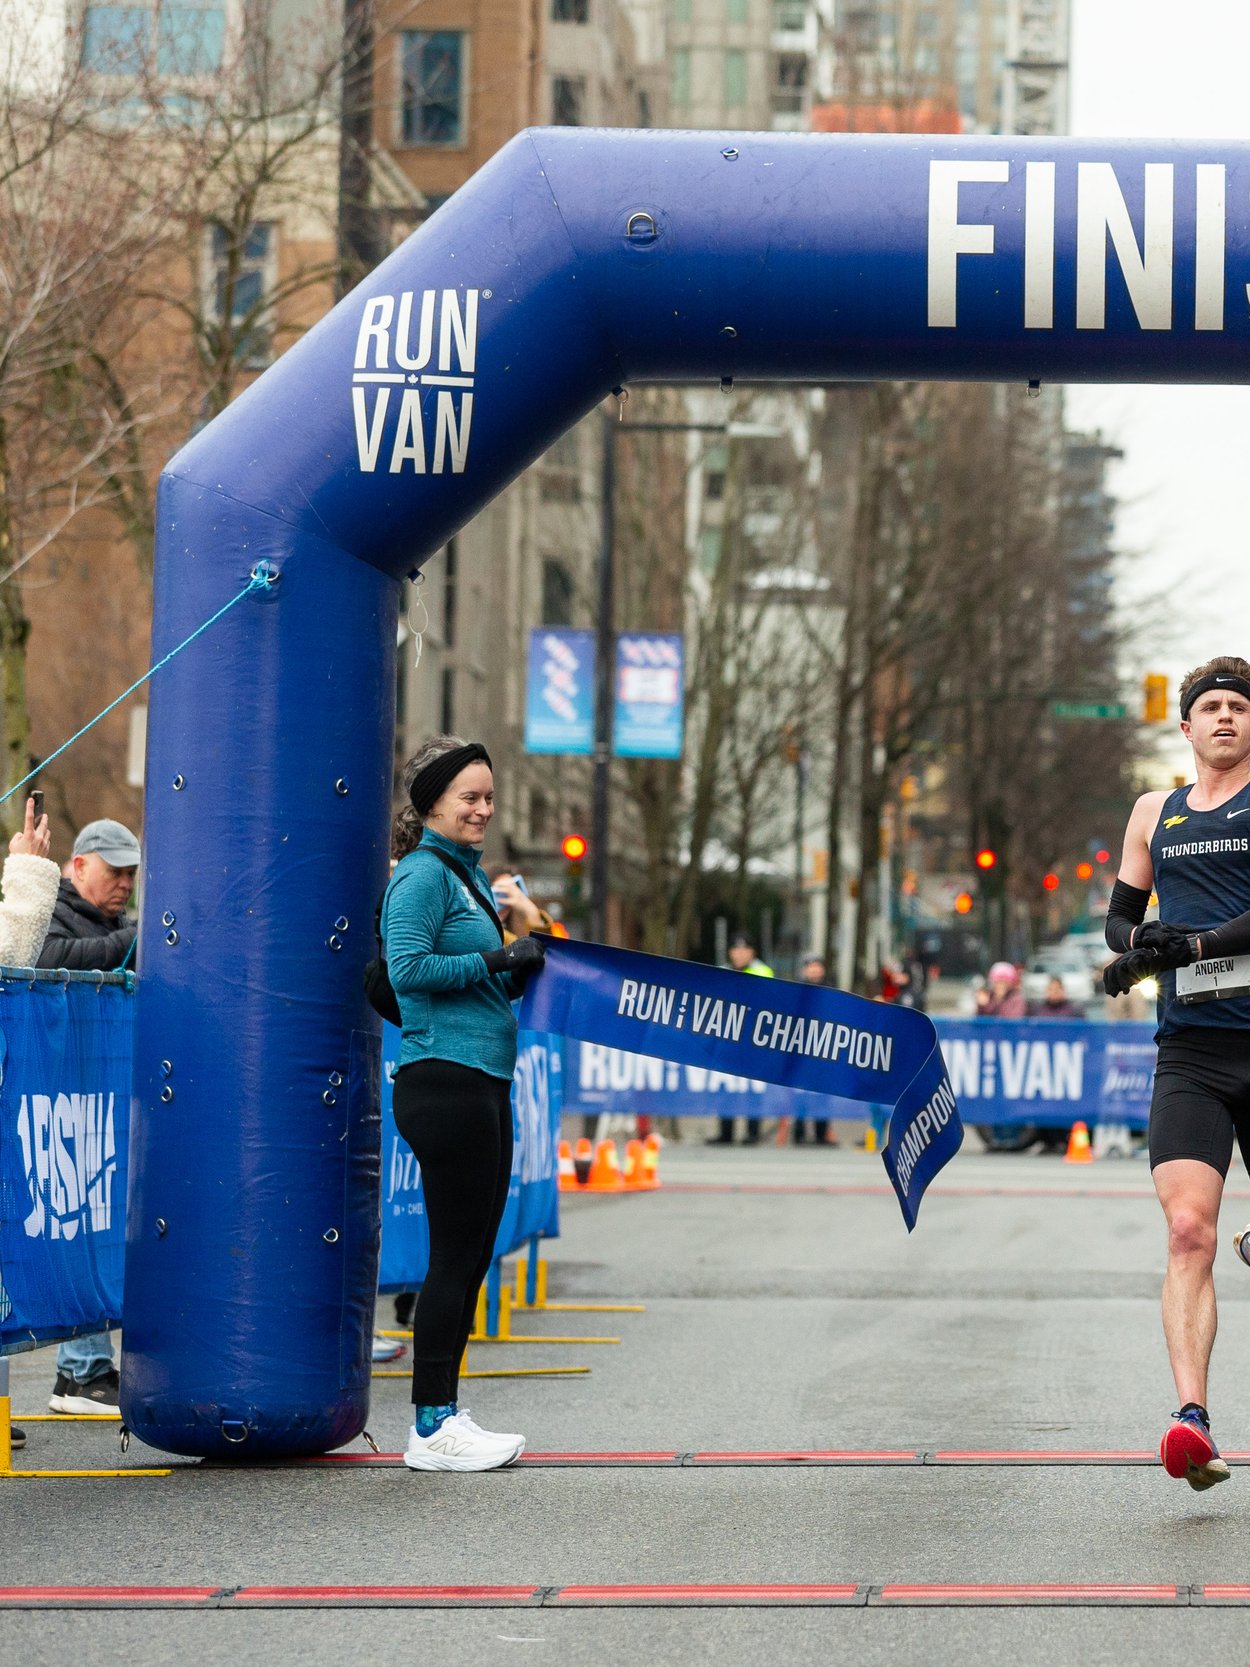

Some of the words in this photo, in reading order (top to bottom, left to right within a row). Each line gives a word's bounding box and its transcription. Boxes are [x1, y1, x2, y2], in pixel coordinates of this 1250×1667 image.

[354, 289, 478, 372] RUN
[352, 387, 473, 474] VAN
[1162, 838, 1249, 859] THUNDERBIRDS
[1195, 959, 1235, 976] ANDREW
[1213, 976, 1218, 986] 1
[617, 978, 676, 1026] RUN
[690, 993, 747, 1042] VAN
[752, 1010, 893, 1072] CHAMPION
[999, 1041, 1085, 1100] VAN
[896, 1077, 957, 1197] CHAMPION
